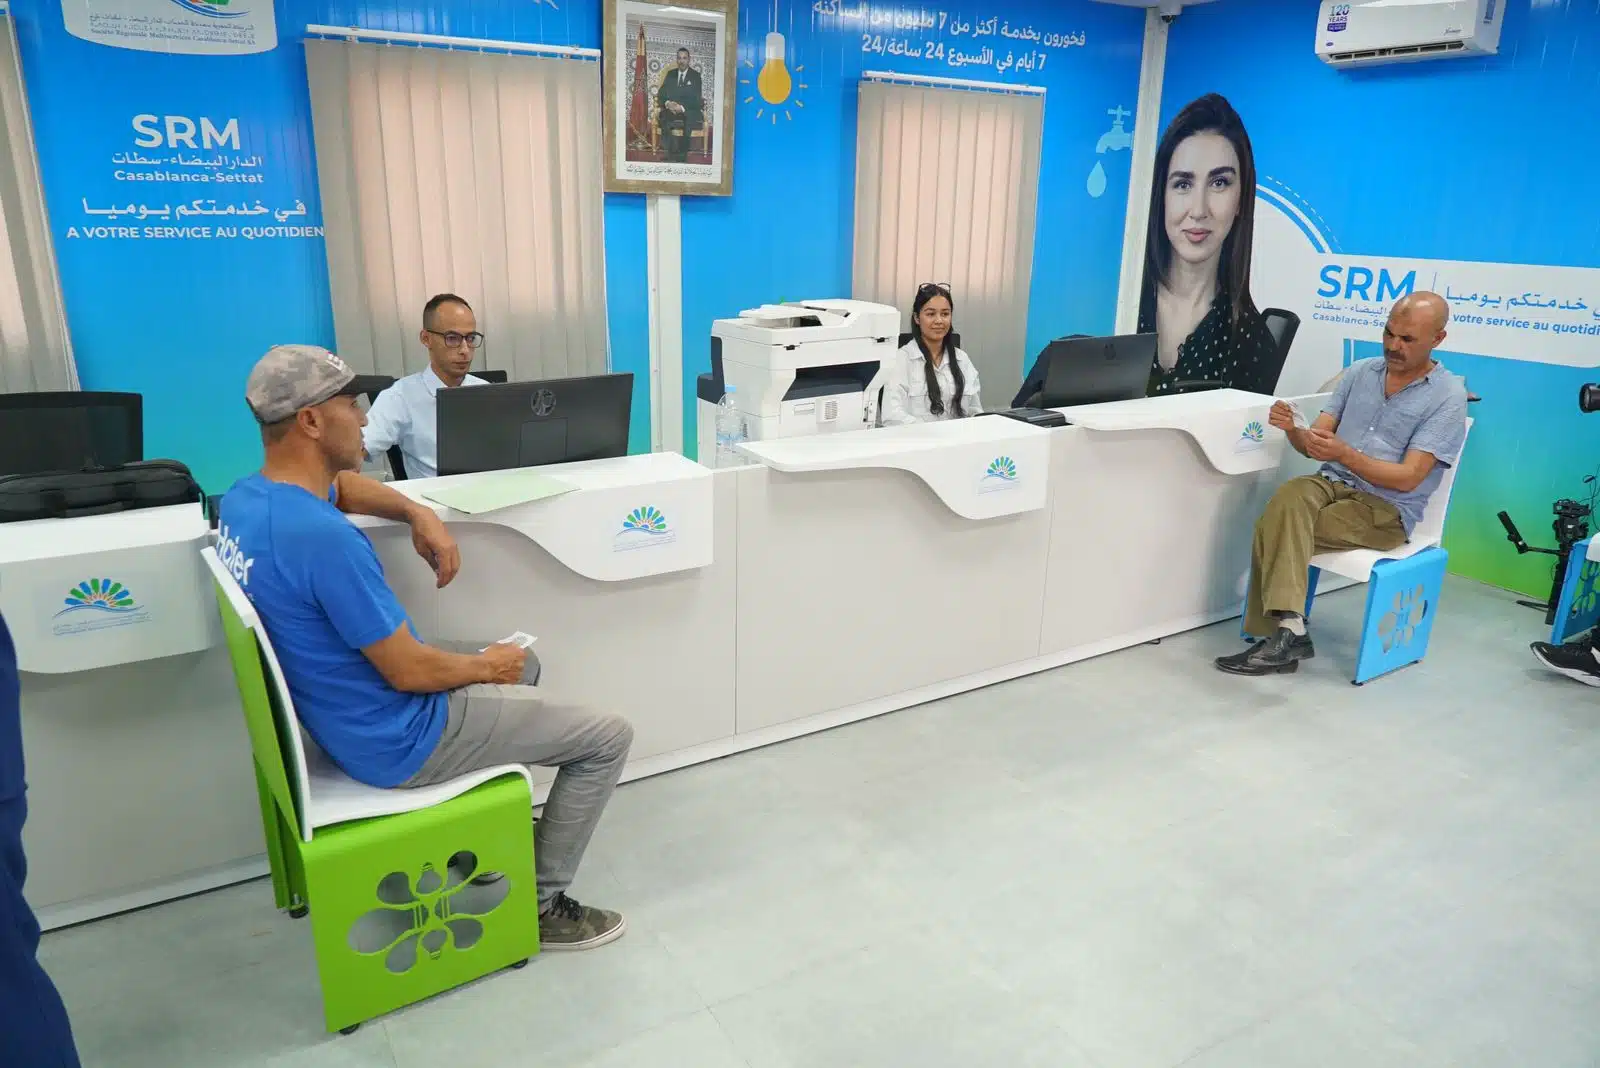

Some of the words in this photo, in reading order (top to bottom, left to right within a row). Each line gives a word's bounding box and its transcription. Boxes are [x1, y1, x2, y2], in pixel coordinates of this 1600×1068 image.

[938, 11, 948, 30] 7
[1330, 4, 1350, 16] 120
[950, 20, 970, 36] من
[971, 16, 998, 38] أكثر
[1000, 21, 1041, 44] بخدمة
[925, 41, 945, 59] 24
[1043, 30, 1086, 48] فخورون
[947, 45, 993, 68] الأسبوع
[996, 51, 1013, 75] في
[1015, 50, 1036, 72] أيام
[1038, 53, 1048, 70] 7
[131, 113, 241, 150] SRM
[113, 169, 265, 184] Casablanca-Settat
[81, 197, 171, 219] يوميا
[175, 199, 270, 221] خدمتكم
[274, 199, 307, 222] في
[66, 226, 80, 239] A
[82, 226, 141, 239] VOTRE
[144, 226, 212, 239] SERVICE
[215, 226, 238, 239] AU
[241, 225, 325, 239] QUOTIDIEN
[1316, 264, 1417, 302] SRM
[1446, 285, 1502, 309] يوميا
[1506, 292, 1589, 312] خدمتكم
[1312, 312, 1386, 328] Casablanca-Se
[1453, 312, 1484, 324] votre
[1486, 316, 1530, 330] service
[1533, 320, 1549, 331] au
[1552, 322, 1600, 336] quotidi
